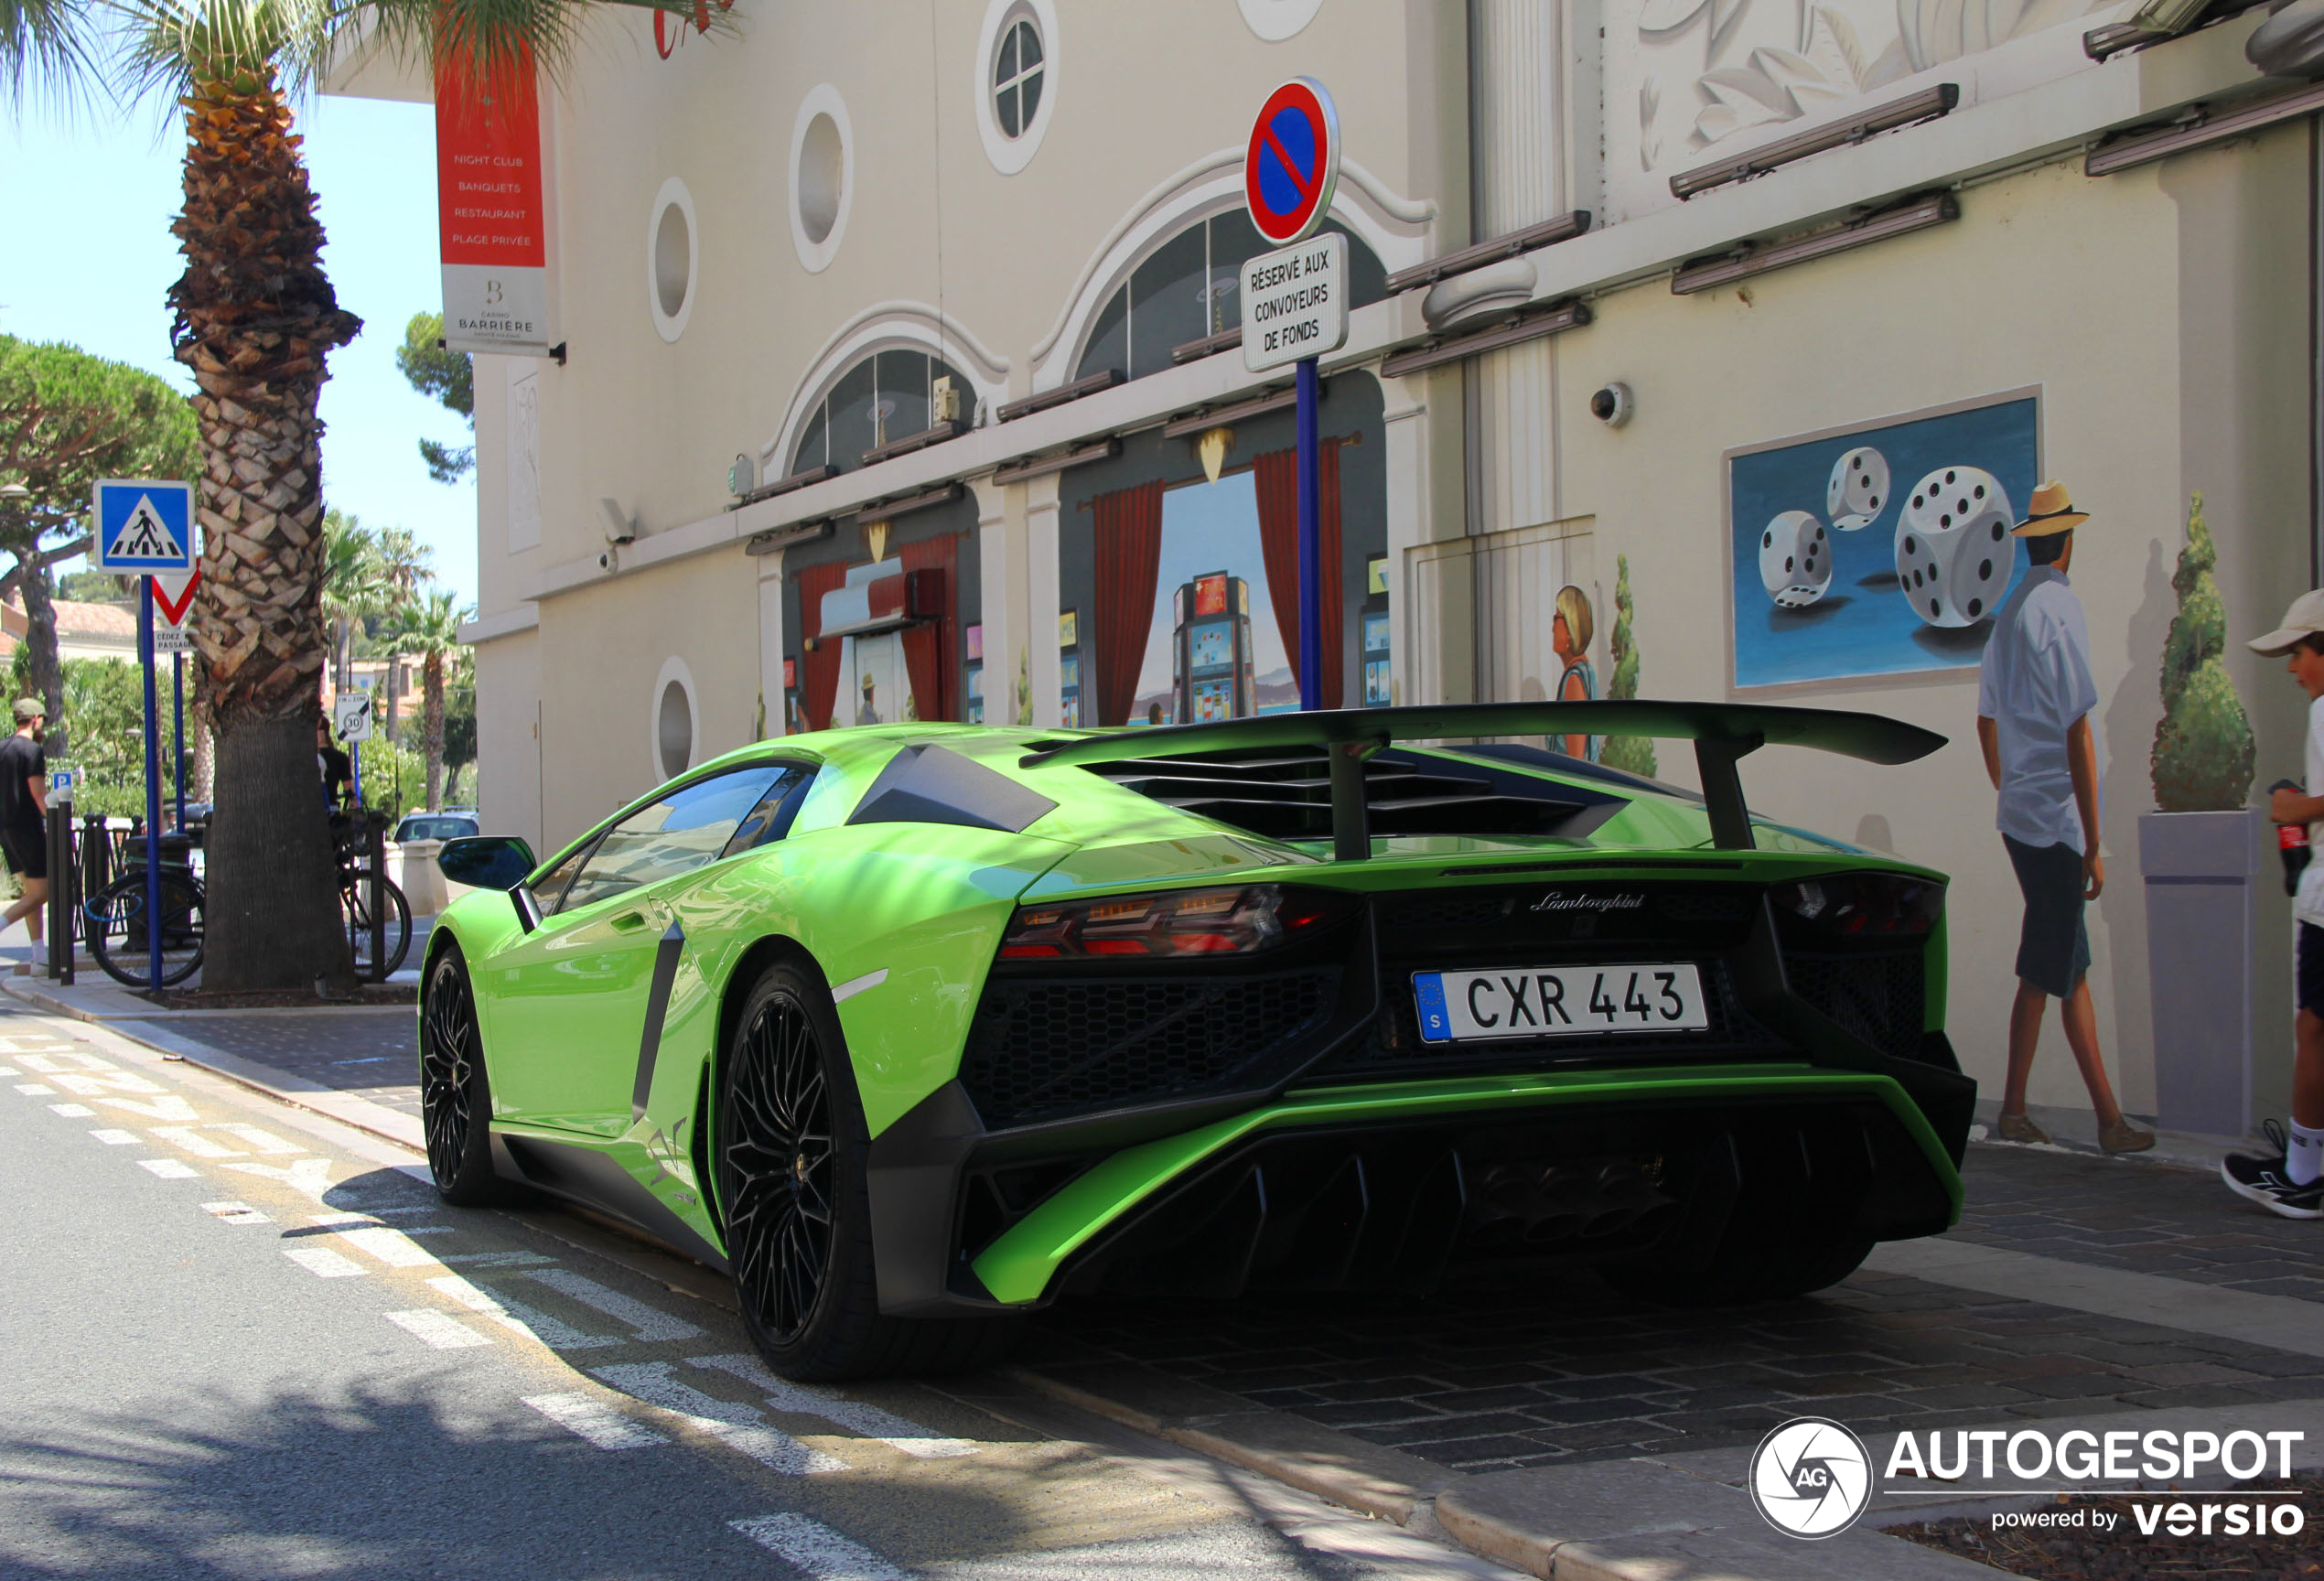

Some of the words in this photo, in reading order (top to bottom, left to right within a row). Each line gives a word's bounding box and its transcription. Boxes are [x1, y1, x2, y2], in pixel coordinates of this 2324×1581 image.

[454, 155, 490, 165] NIGHT
[493, 156, 523, 167] CLUB
[458, 181, 522, 193] BANQUETS
[454, 208, 527, 220] RESTAURANT
[453, 234, 488, 245] PLAGE
[491, 234, 532, 247] PRIVÉE
[1251, 255, 1300, 293] RÉSERVÉ
[1305, 250, 1329, 276] AUX
[1255, 284, 1328, 323] CONVOYEURS
[459, 318, 533, 333] BARRIÈRE
[1264, 330, 1279, 352] DE
[1283, 319, 1319, 348] FONDS
[348, 717, 360, 728] 30
[58, 774, 68, 788] P
[1530, 891, 1646, 912] Lamborghini
[1430, 1014, 1441, 1028] S
[1468, 975, 1573, 1028] CXR
[1588, 972, 1684, 1023] 443
